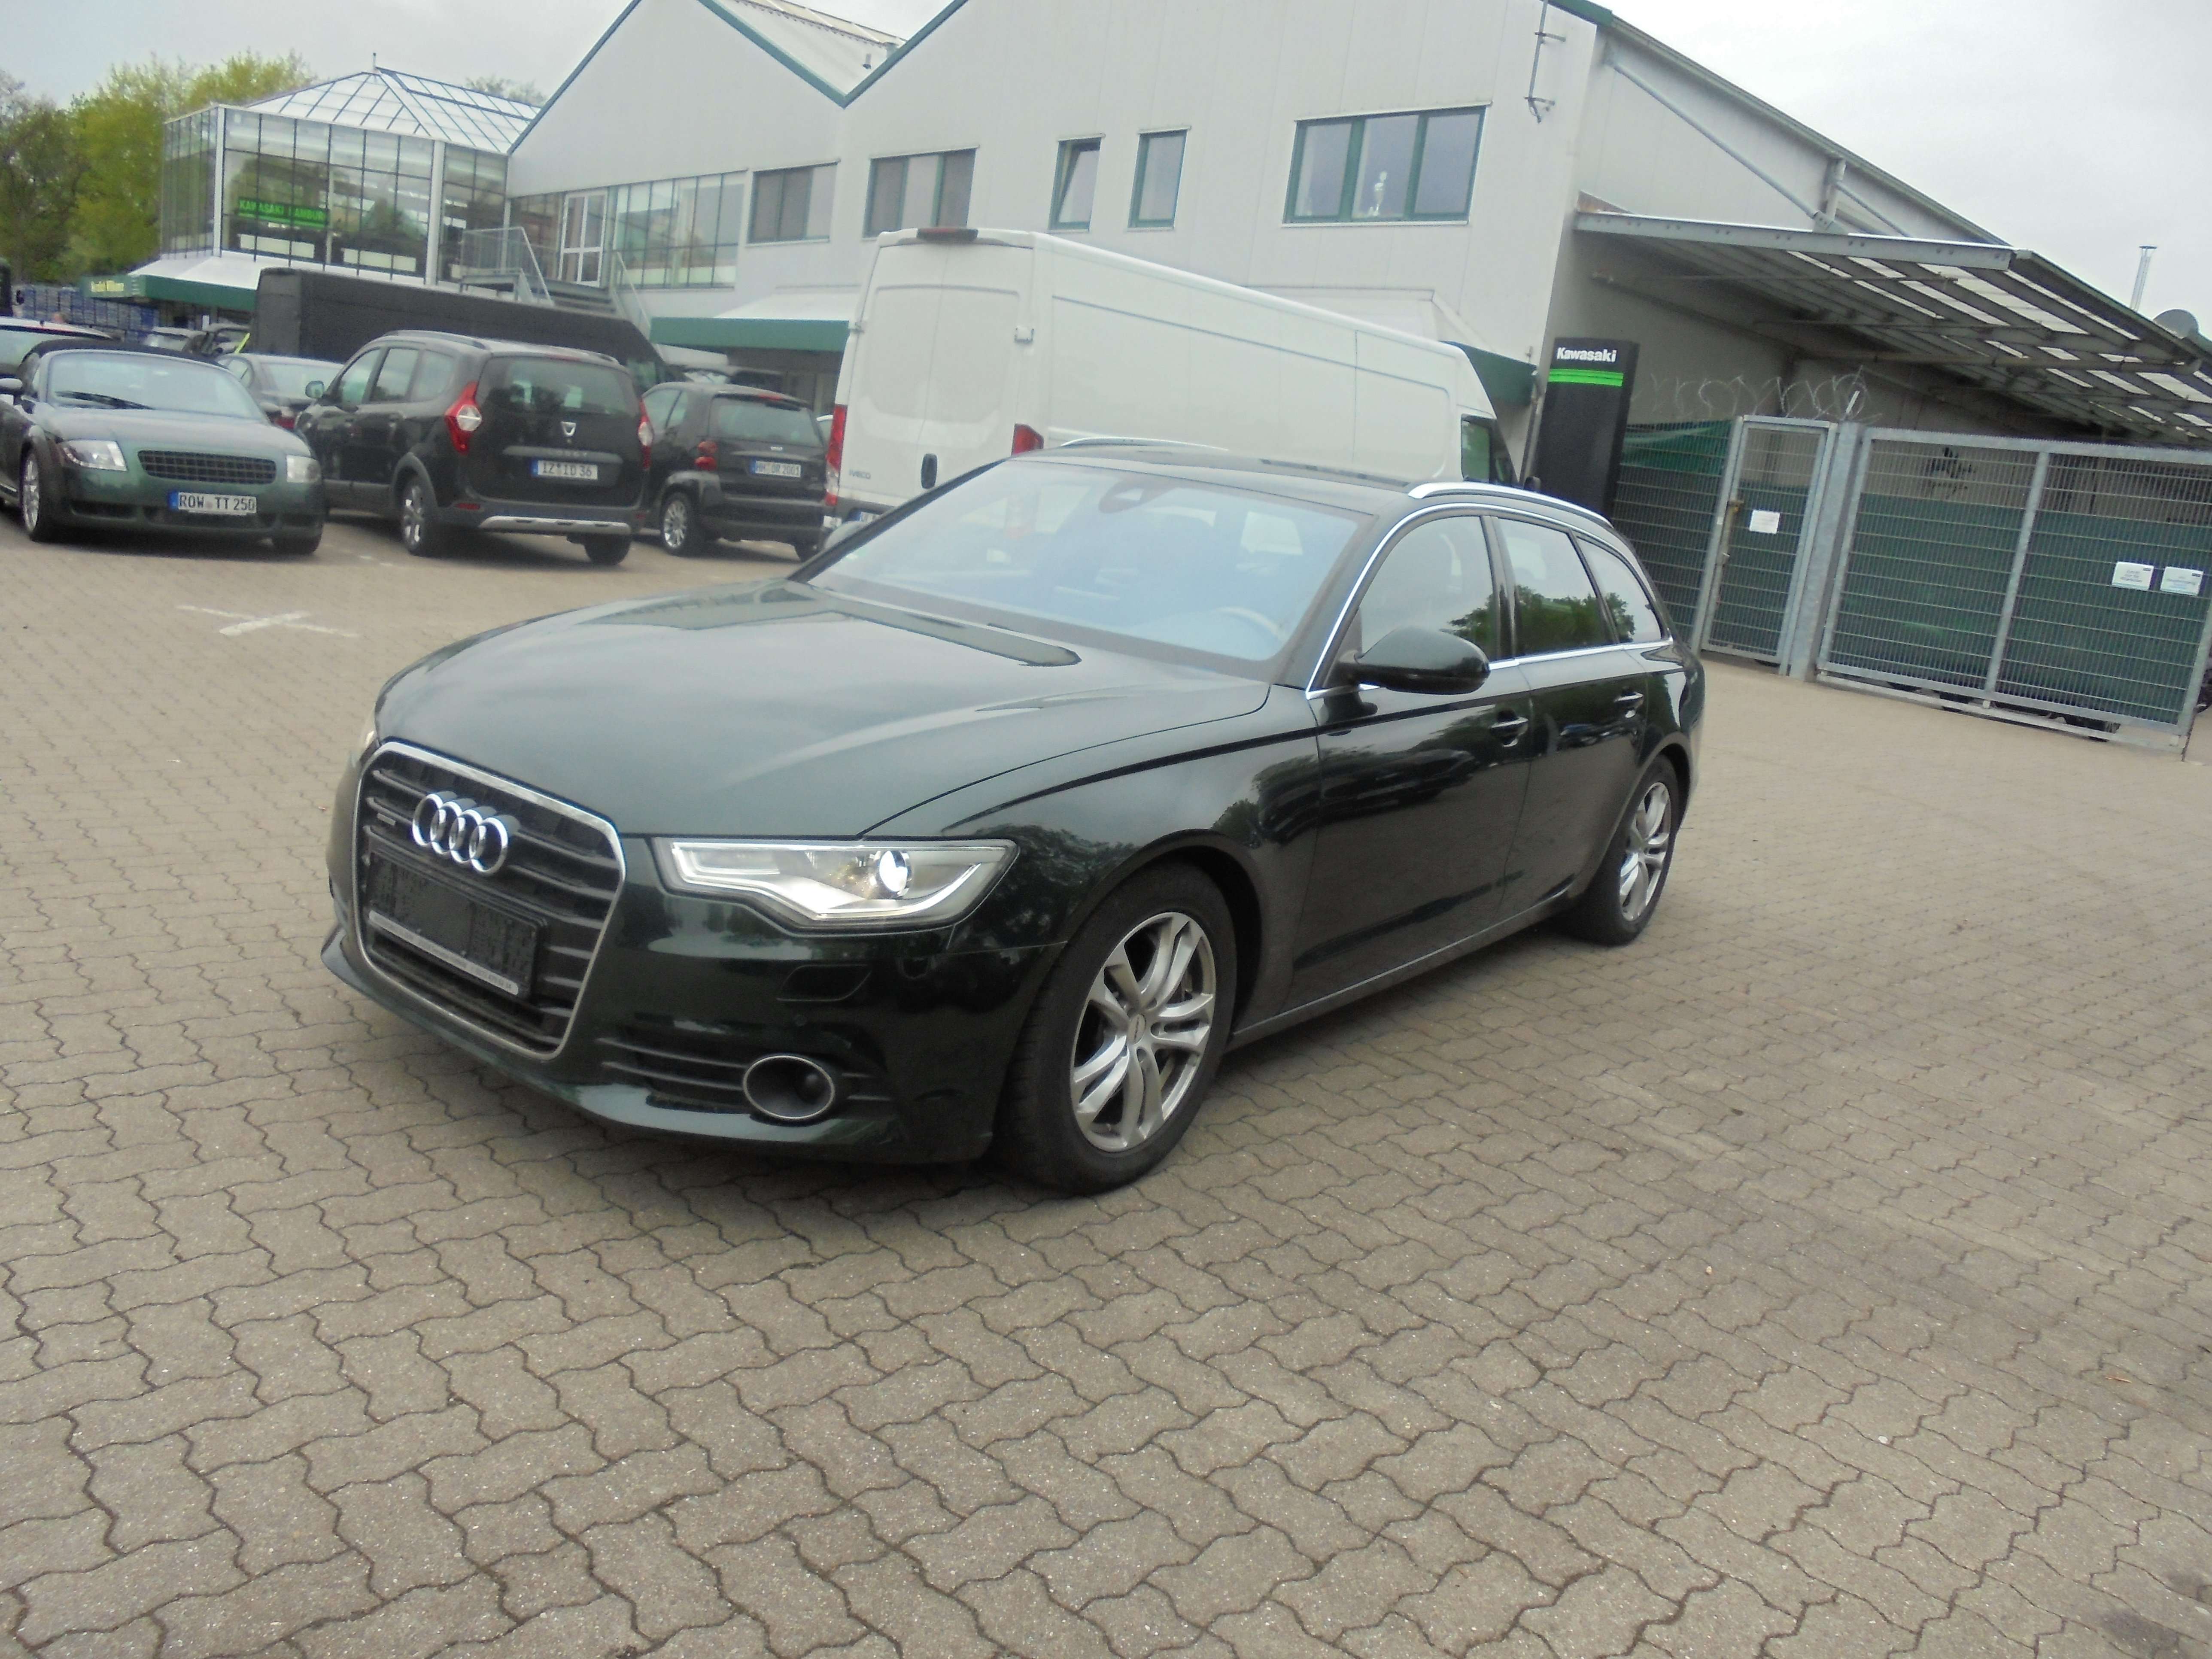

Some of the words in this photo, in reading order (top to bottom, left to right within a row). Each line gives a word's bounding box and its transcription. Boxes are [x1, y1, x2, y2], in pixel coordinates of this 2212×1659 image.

[1557, 347, 1616, 362] Kawasaki
[179, 495, 204, 508] ROW
[215, 497, 229, 510] TT
[234, 498, 255, 511] 250
